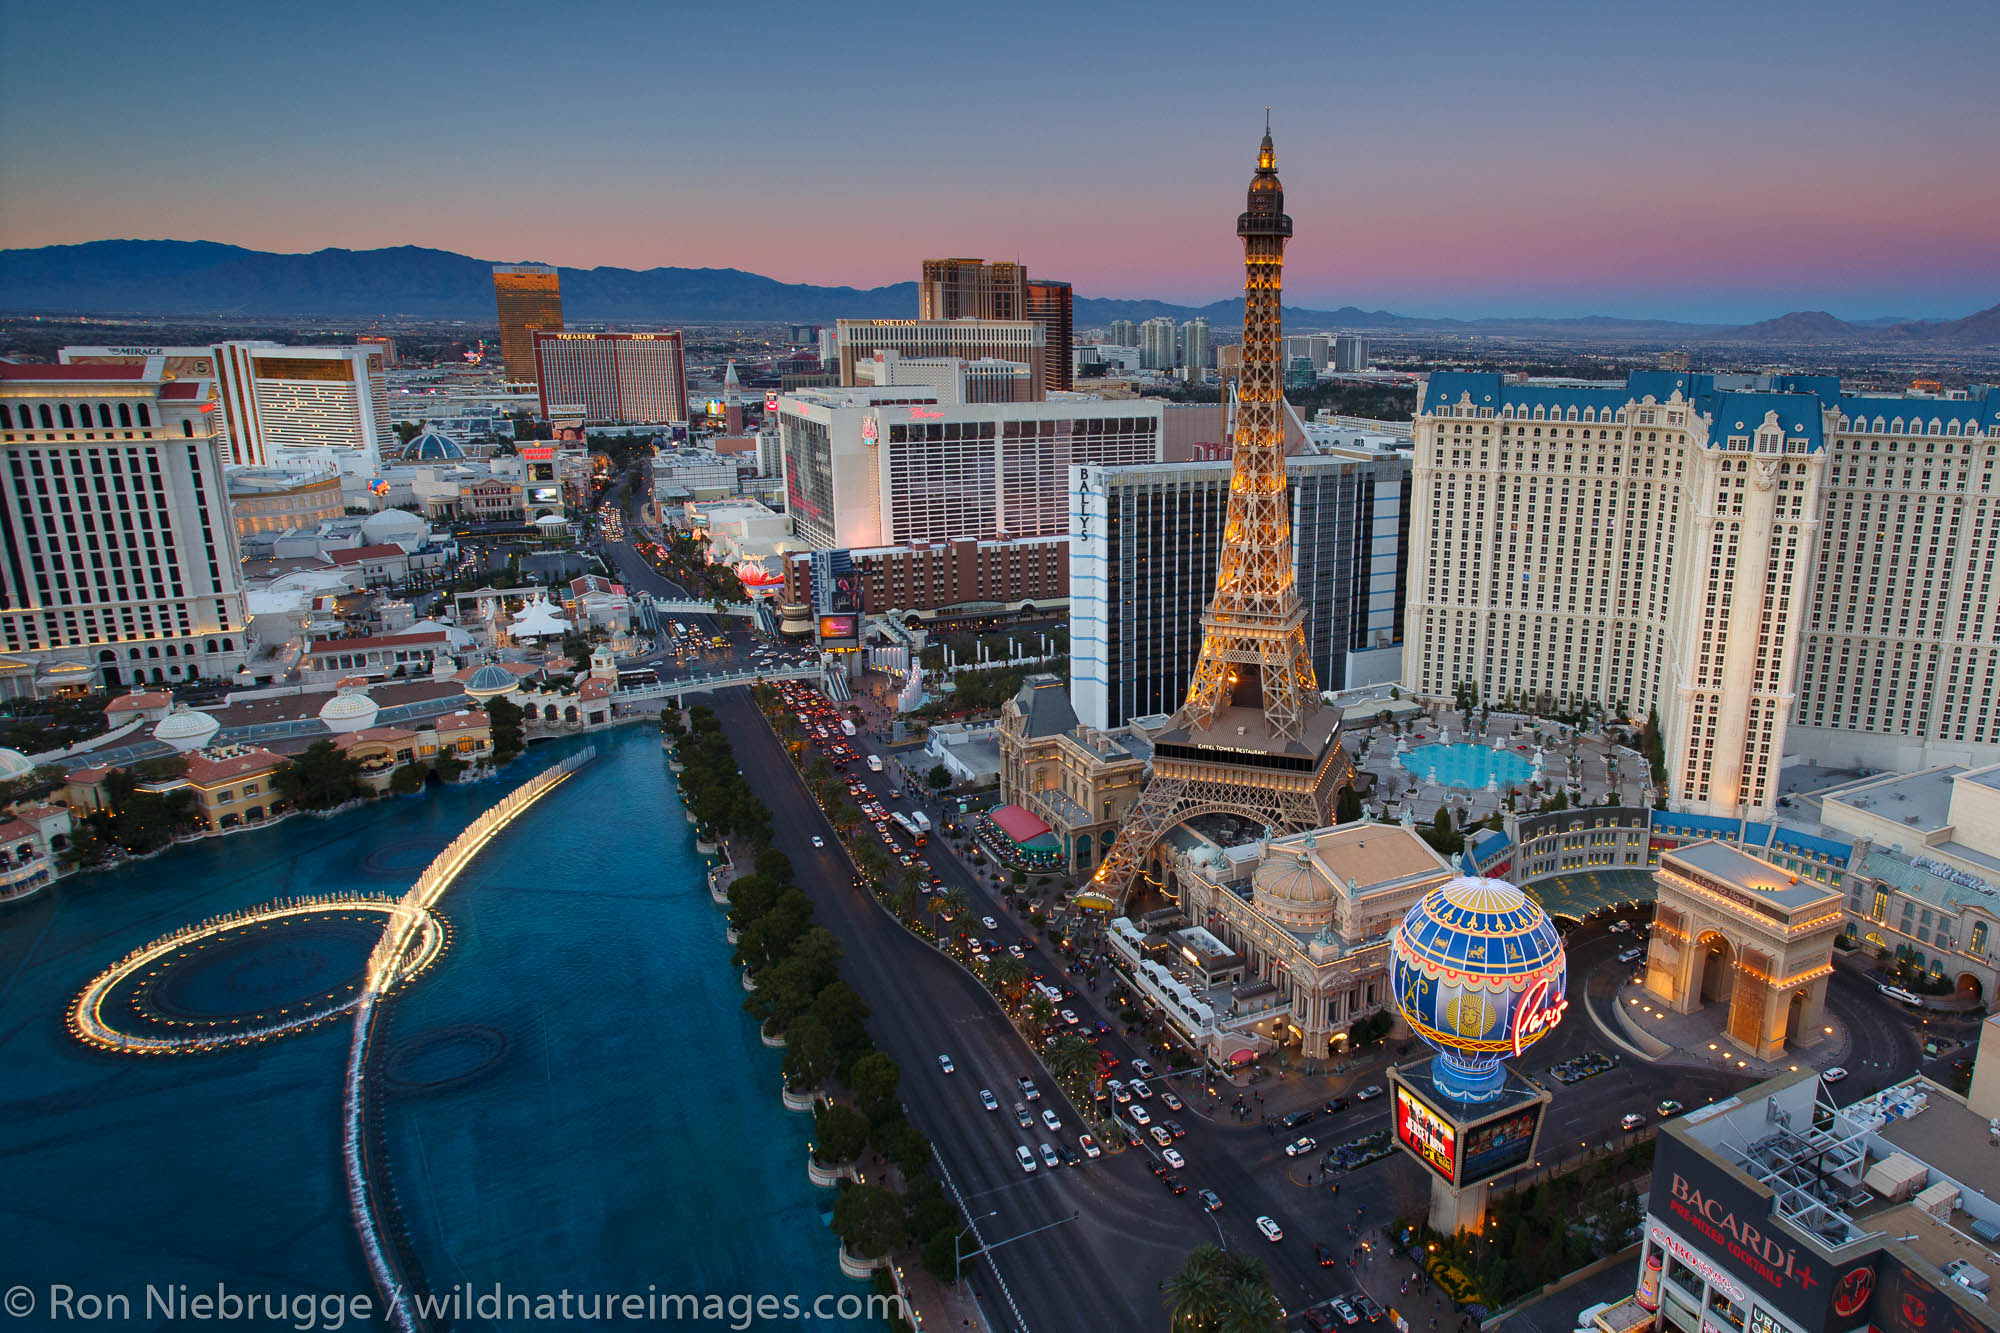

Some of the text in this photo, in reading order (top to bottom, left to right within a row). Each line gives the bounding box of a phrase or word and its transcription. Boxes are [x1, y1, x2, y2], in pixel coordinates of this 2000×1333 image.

[120, 347, 164, 356] MIRAGE
[1197, 743, 1267, 756] EIFFEL TOWER RESTAURANT
[1512, 977, 1569, 1057] Paris
[1406, 1116, 1429, 1144] JERSEY
[1652, 1227, 1697, 1267] CABO
[1669, 1199, 1725, 1246] PRE-MIXED
[1727, 1241, 1783, 1289] COCKTAILS
